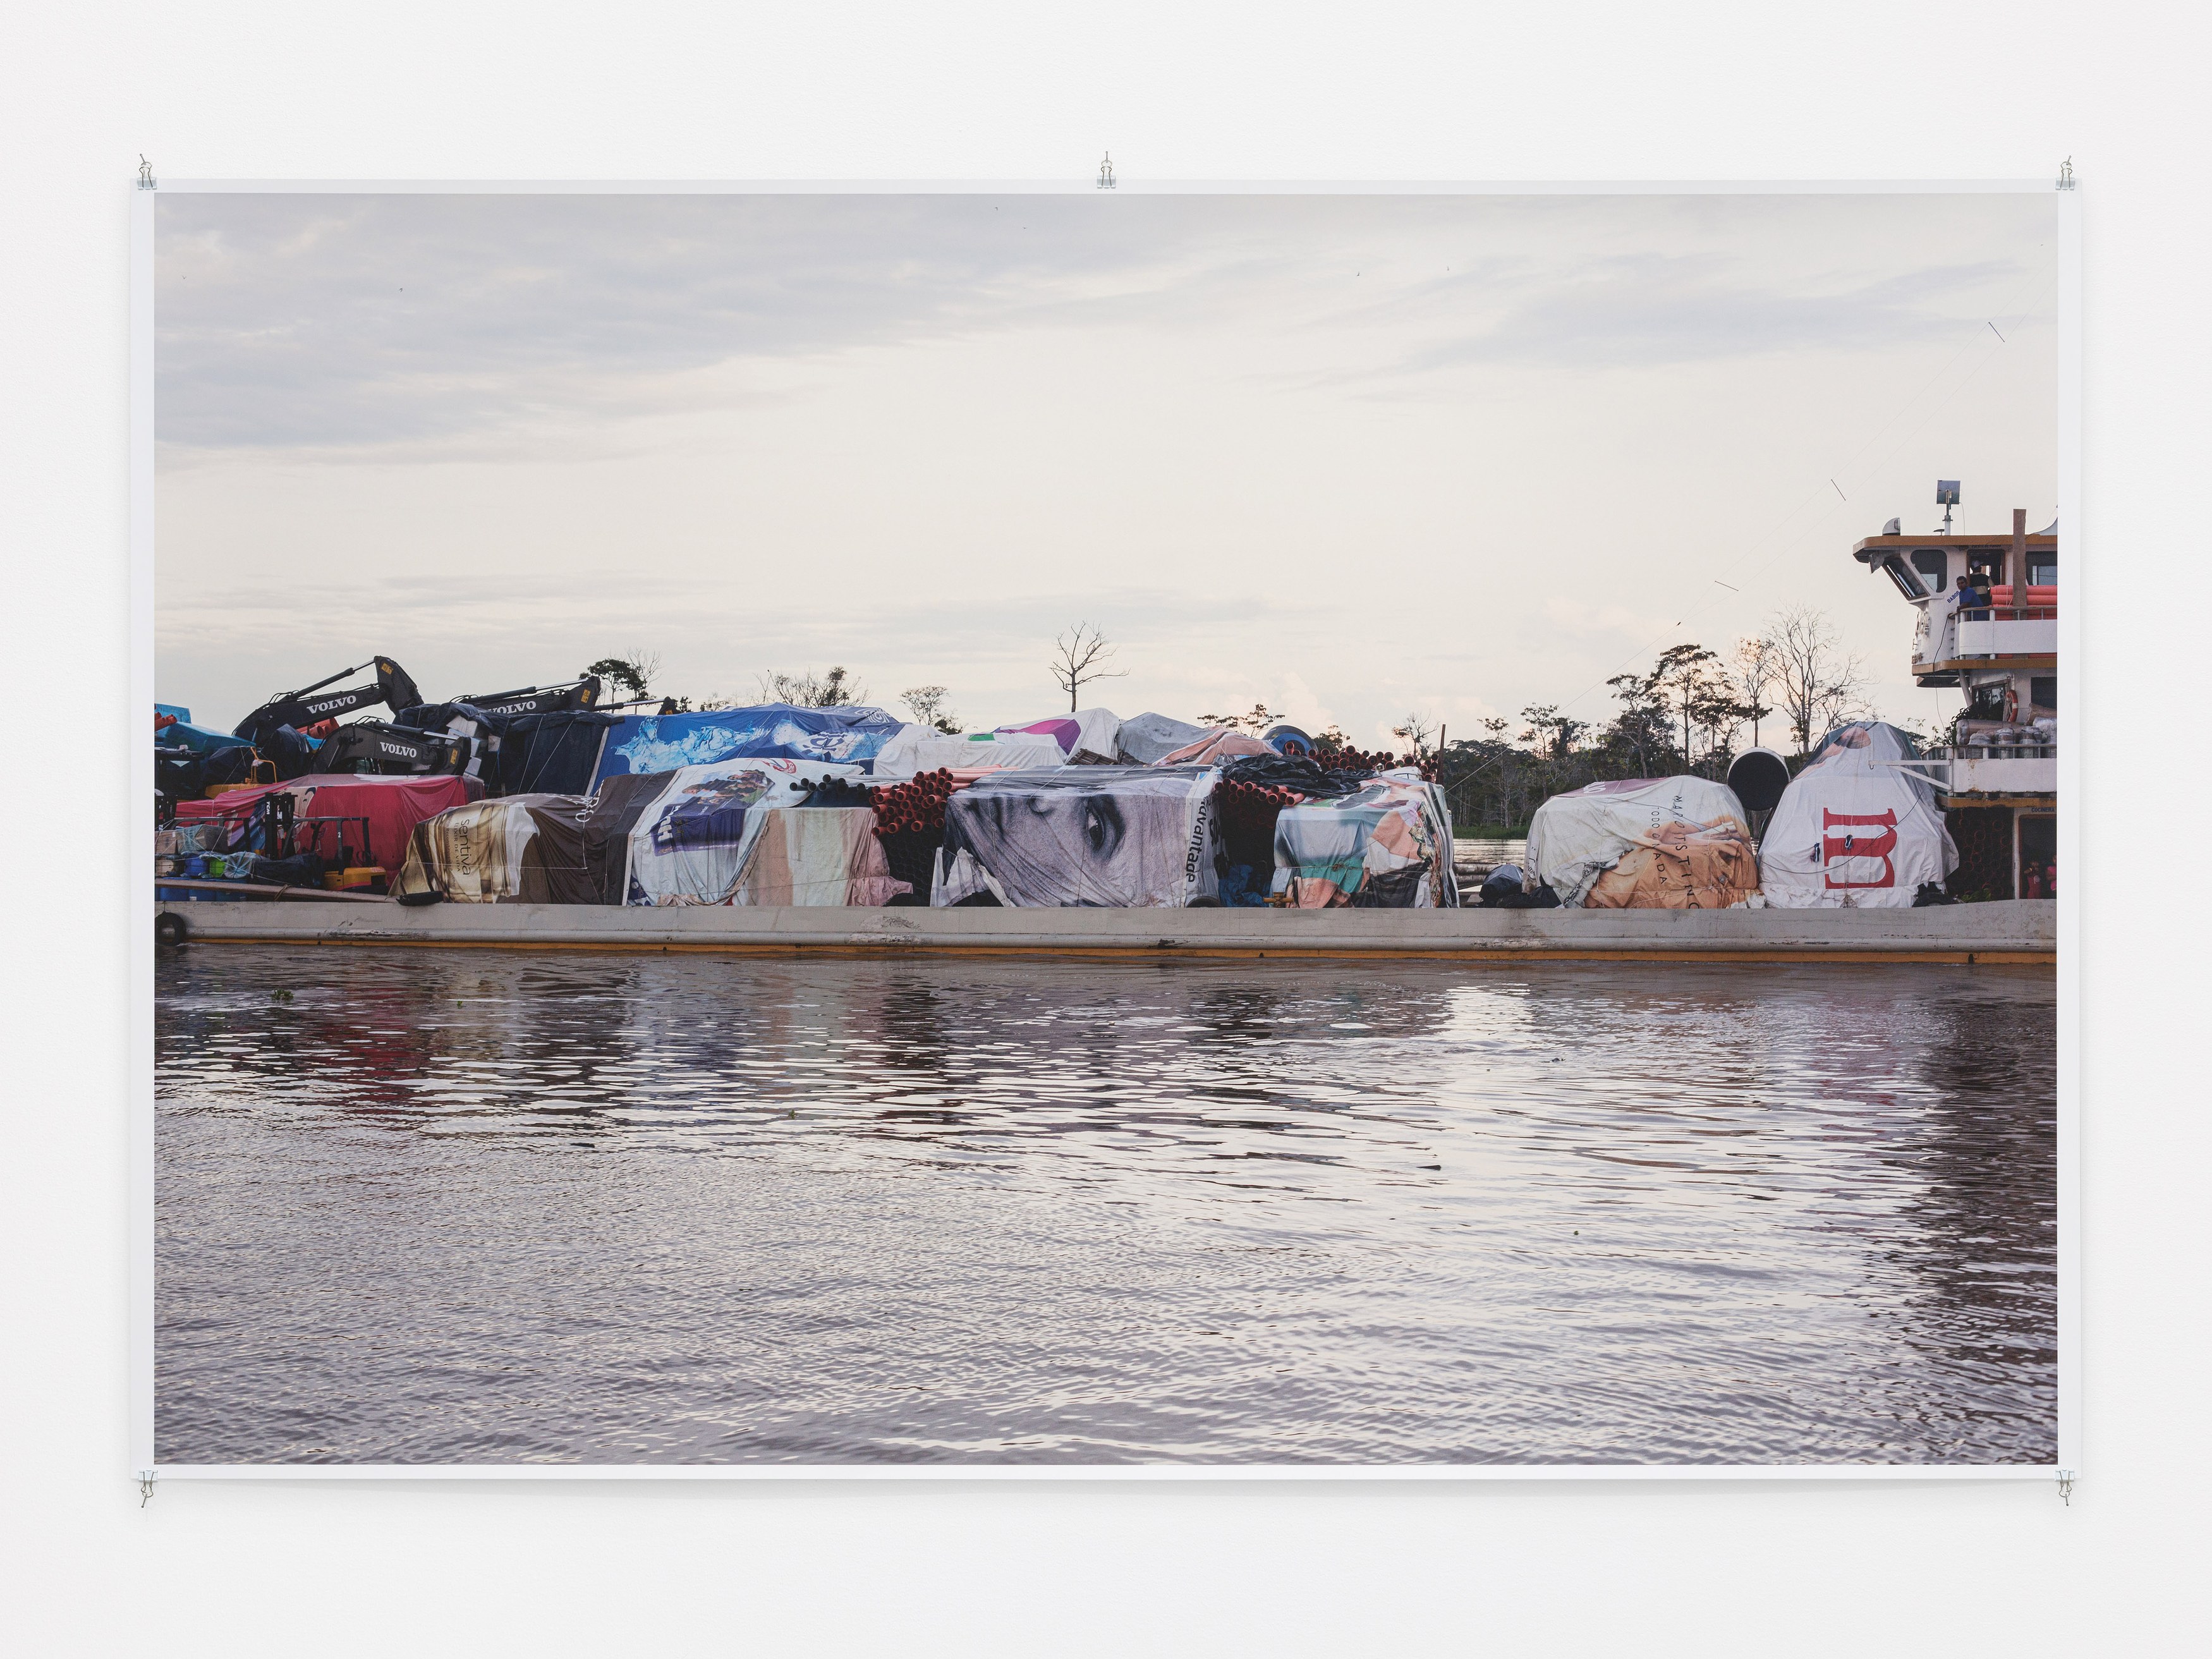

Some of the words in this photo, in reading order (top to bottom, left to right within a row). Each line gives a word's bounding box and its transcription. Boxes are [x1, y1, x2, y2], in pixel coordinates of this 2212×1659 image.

[307, 695, 356, 714] VOLVO
[488, 701, 536, 714] OLVO
[380, 741, 417, 758] VOLVO
[454, 844, 459, 853] DE
[459, 819, 471, 875] sentiva
